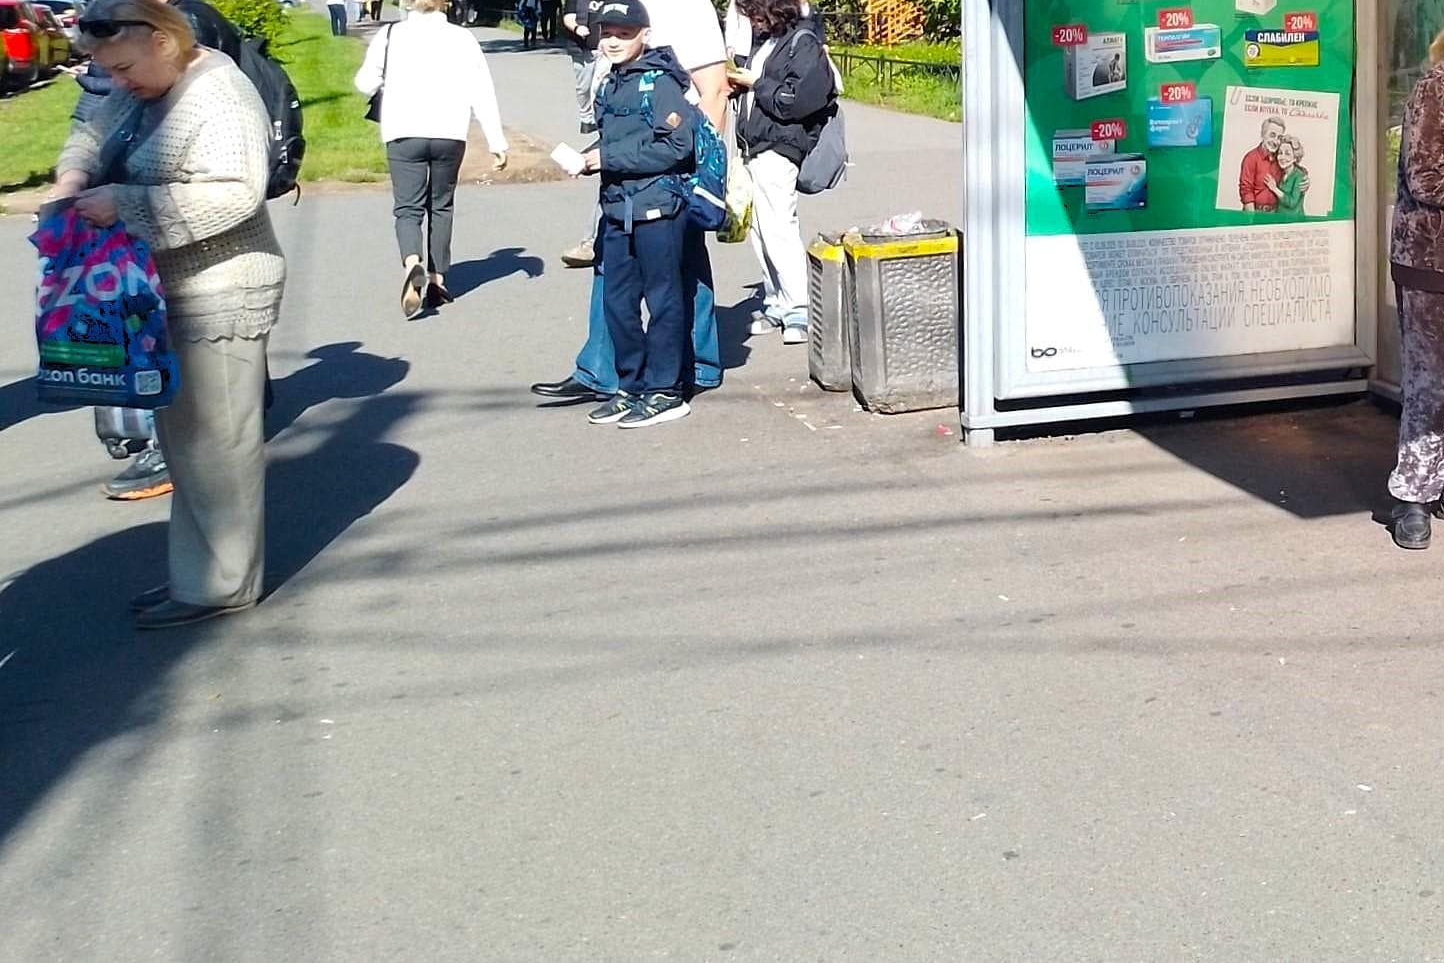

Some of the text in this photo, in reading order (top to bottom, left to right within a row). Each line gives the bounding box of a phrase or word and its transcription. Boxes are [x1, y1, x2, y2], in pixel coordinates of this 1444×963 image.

[1161, 12, 1189, 27] -20%
[1286, 15, 1313, 30] -20%
[1055, 28, 1084, 42] -20%
[1257, 32, 1305, 43] СЛАБИЛЕН
[1163, 86, 1191, 101] -20%
[1094, 123, 1122, 137] -20%
[1251, 274, 1332, 303] НЕОБХОДИМО
[1134, 306, 1236, 336] КОНСУЛЬТАЦИИ
[1244, 299, 1332, 328] СПЕЦИАЛИСТА
[78, 368, 127, 386] банк
